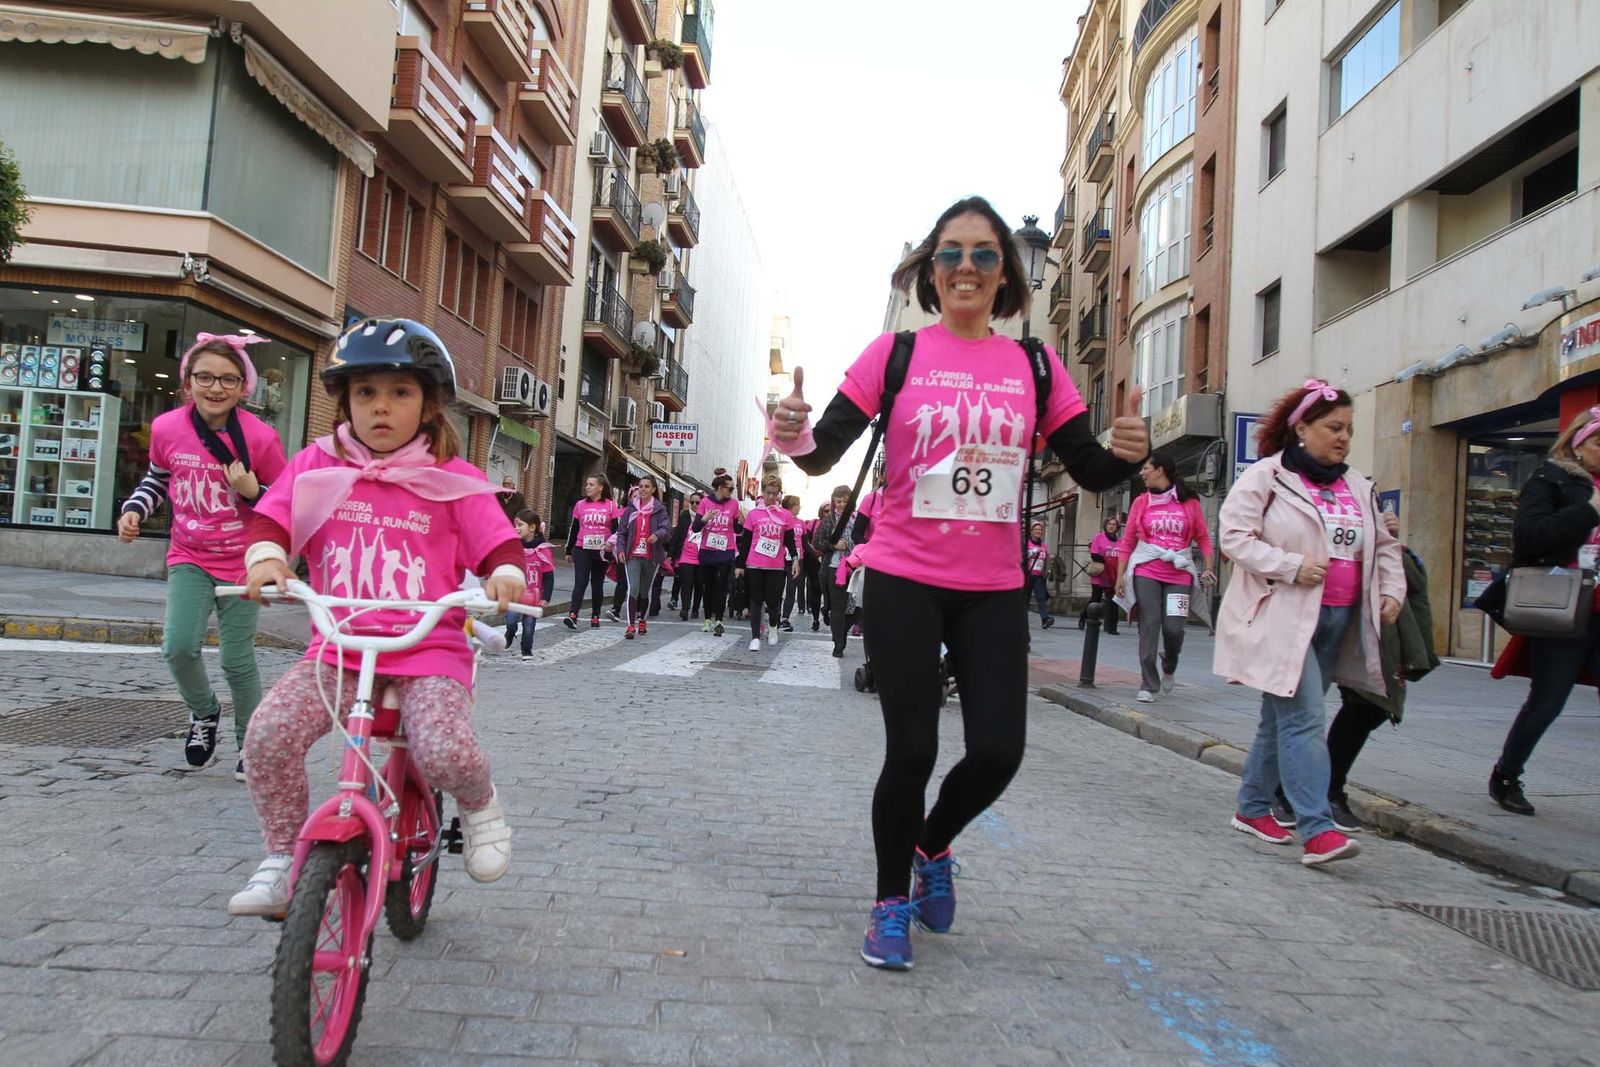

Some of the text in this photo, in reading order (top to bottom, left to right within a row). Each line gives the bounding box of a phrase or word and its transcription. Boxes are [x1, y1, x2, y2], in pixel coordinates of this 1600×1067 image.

[52, 319, 138, 334] ACCESORIOS
[929, 369, 973, 381] CARRERA
[1003, 377, 1024, 387] PINK
[911, 377, 923, 386] DE
[926, 378, 938, 386] LA
[940, 379, 973, 389] MUJER
[983, 383, 1025, 395] RUNNING
[655, 431, 694, 440] CASERO
[174, 453, 201, 461] CARRERA
[952, 467, 991, 496] 63
[337, 511, 372, 524] MUJER
[373, 517, 380, 526] &
[382, 516, 430, 534] RUNNING
[408, 510, 432, 525] PINK
[1333, 527, 1356, 546] 89
[761, 542, 776, 552] 623
